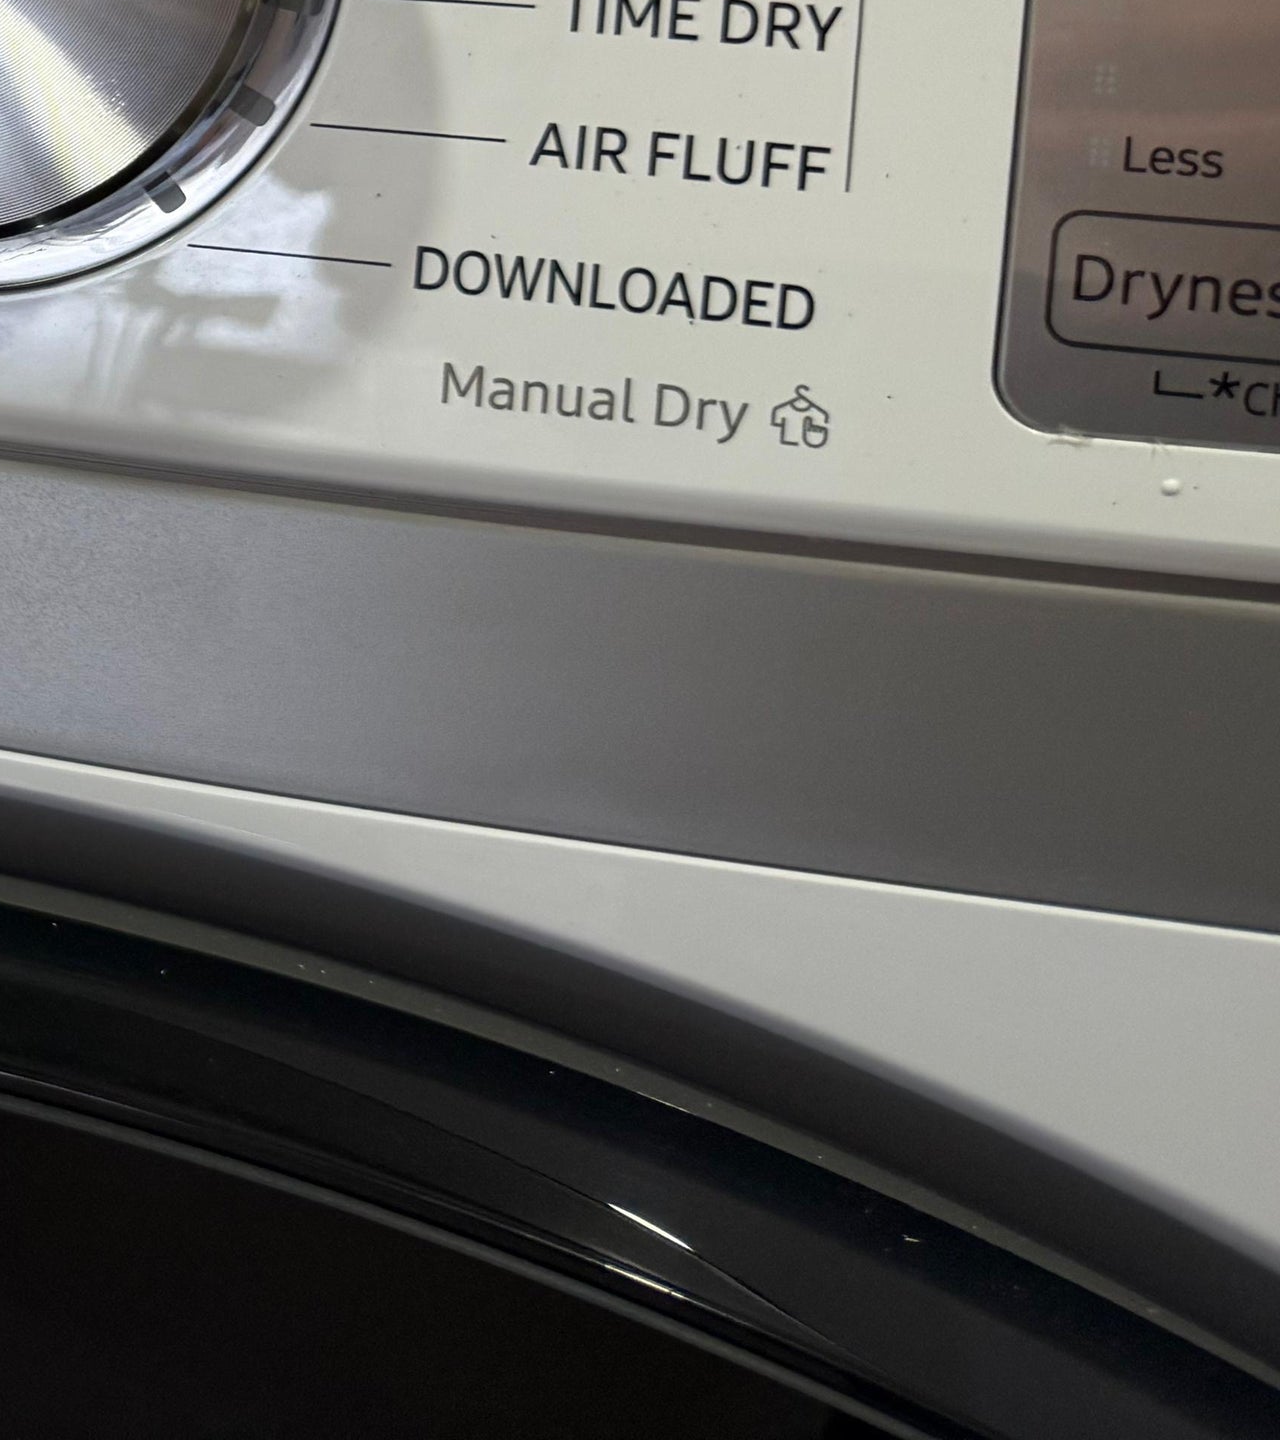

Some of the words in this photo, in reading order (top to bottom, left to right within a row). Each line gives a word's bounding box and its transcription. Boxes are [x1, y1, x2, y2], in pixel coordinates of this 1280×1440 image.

[529, 121, 629, 175] AIR
[647, 131, 833, 193] FLUFF
[1123, 136, 1224, 180] Less
[413, 245, 816, 330] DOWNLOADED
[440, 361, 636, 425] Manual
[654, 382, 750, 445] Dry
